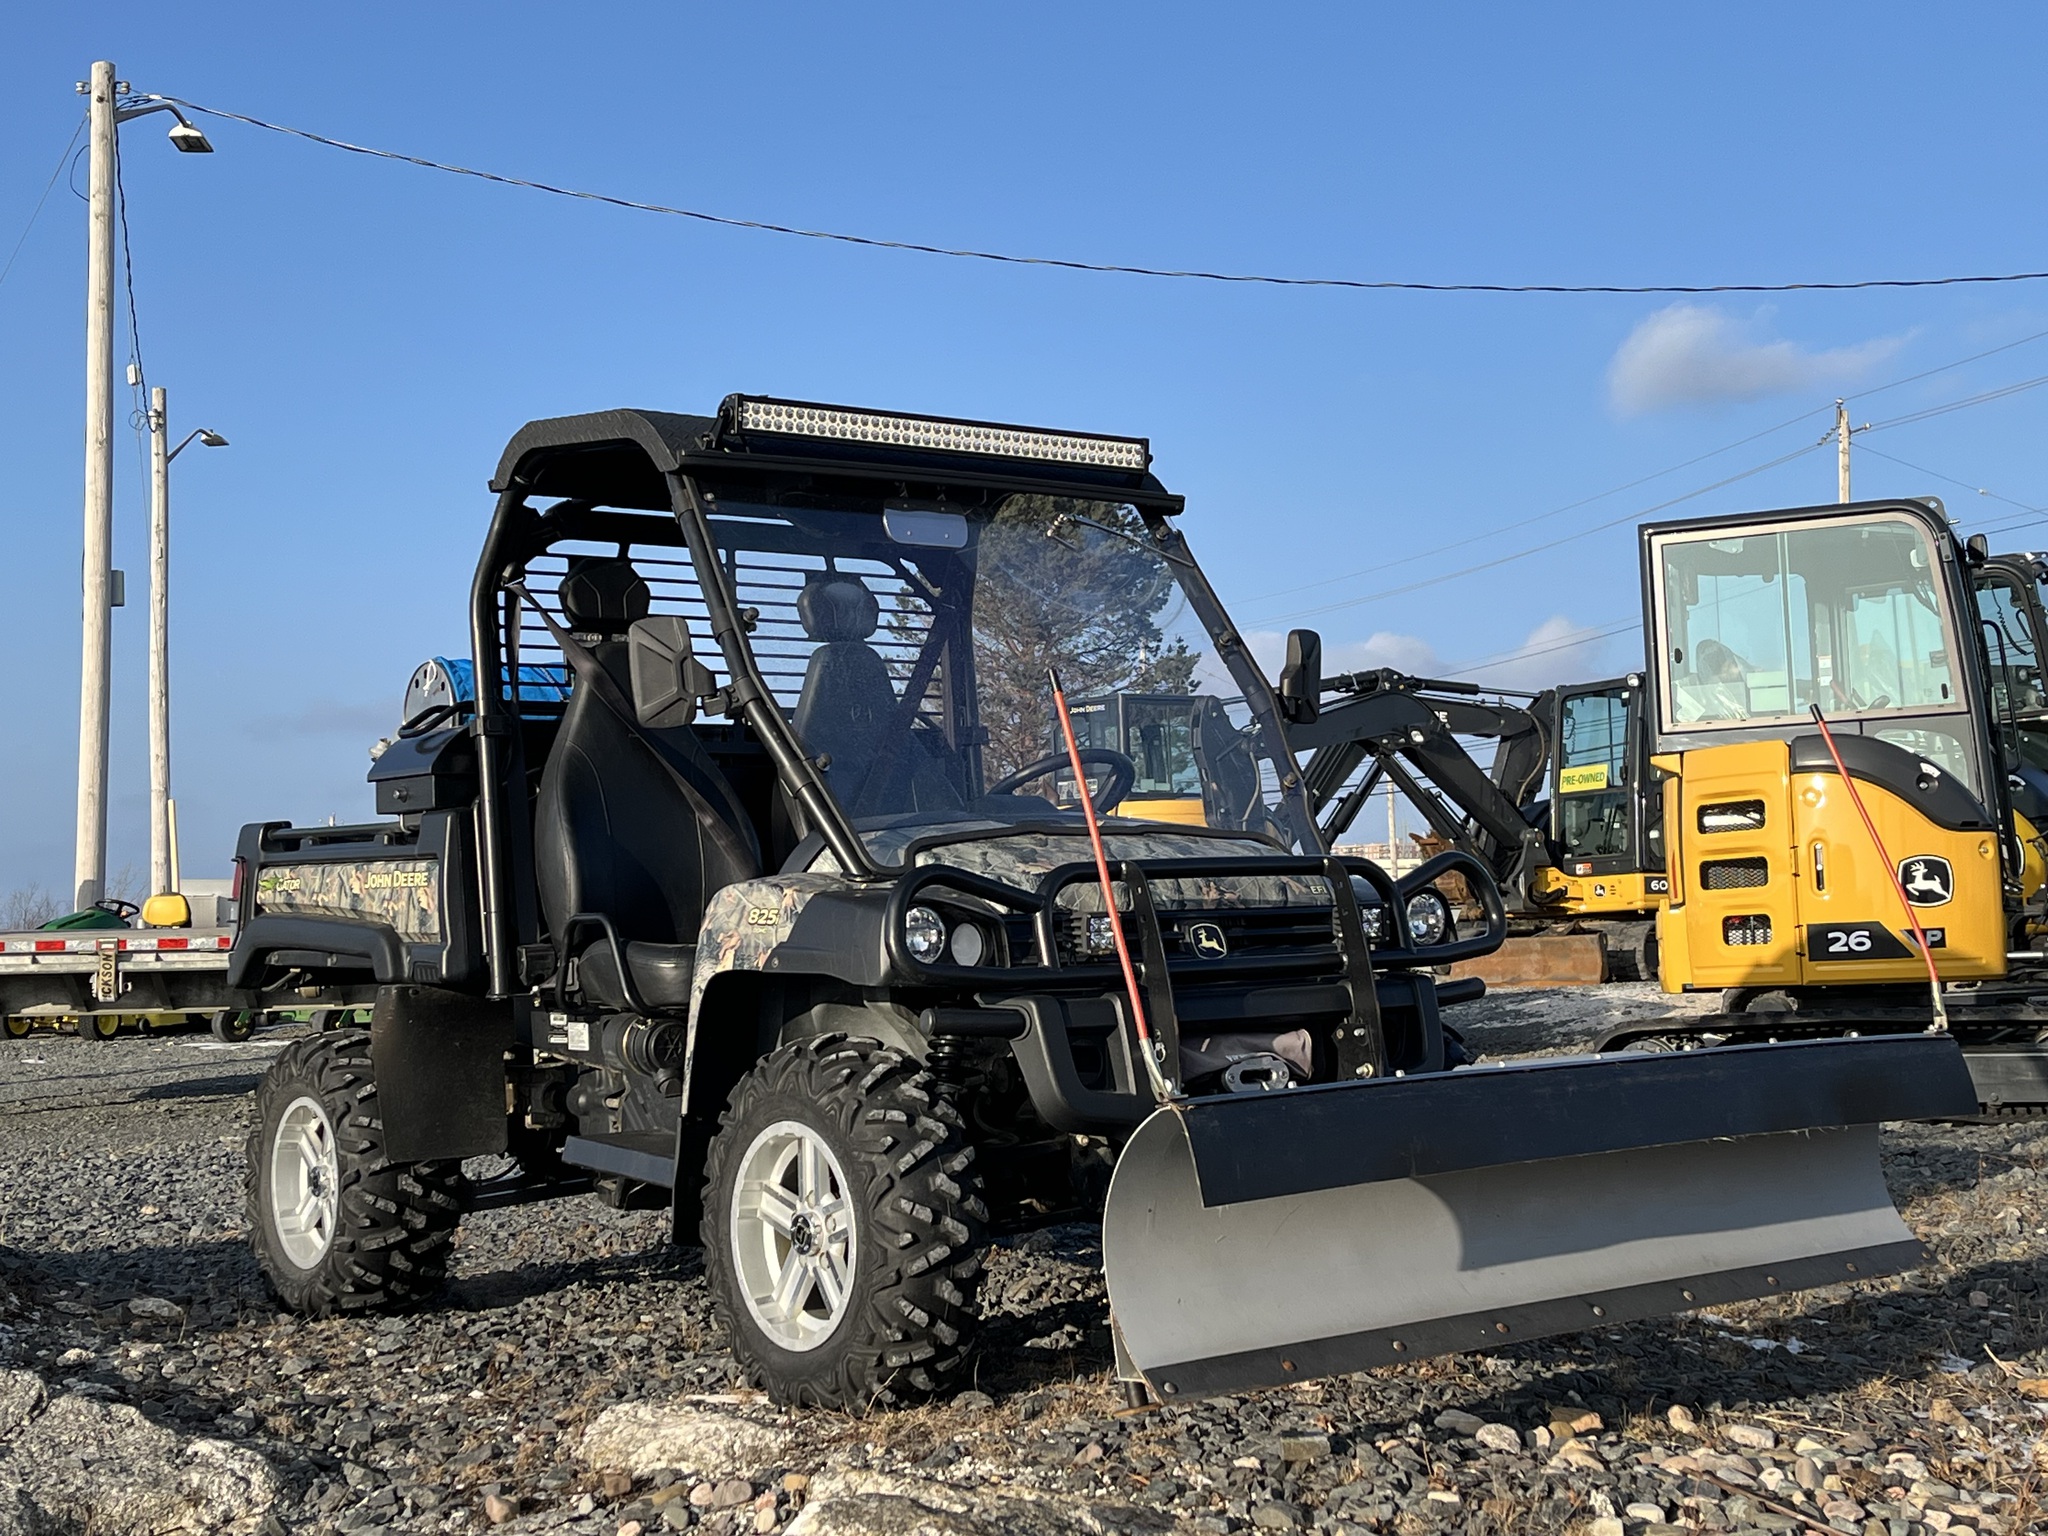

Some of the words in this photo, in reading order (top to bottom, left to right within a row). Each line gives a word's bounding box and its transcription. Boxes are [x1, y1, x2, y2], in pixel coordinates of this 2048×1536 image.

[1070, 706, 1085, 714] JOHN
[1086, 704, 1105, 712] DEERE
[1562, 772, 1605, 785] PRE-OWNED
[276, 879, 300, 891] GATOR
[364, 872, 392, 889] JOHN
[393, 870, 428, 887] DEERE
[1650, 880, 1668, 891] 60
[1827, 930, 1872, 953] 26
